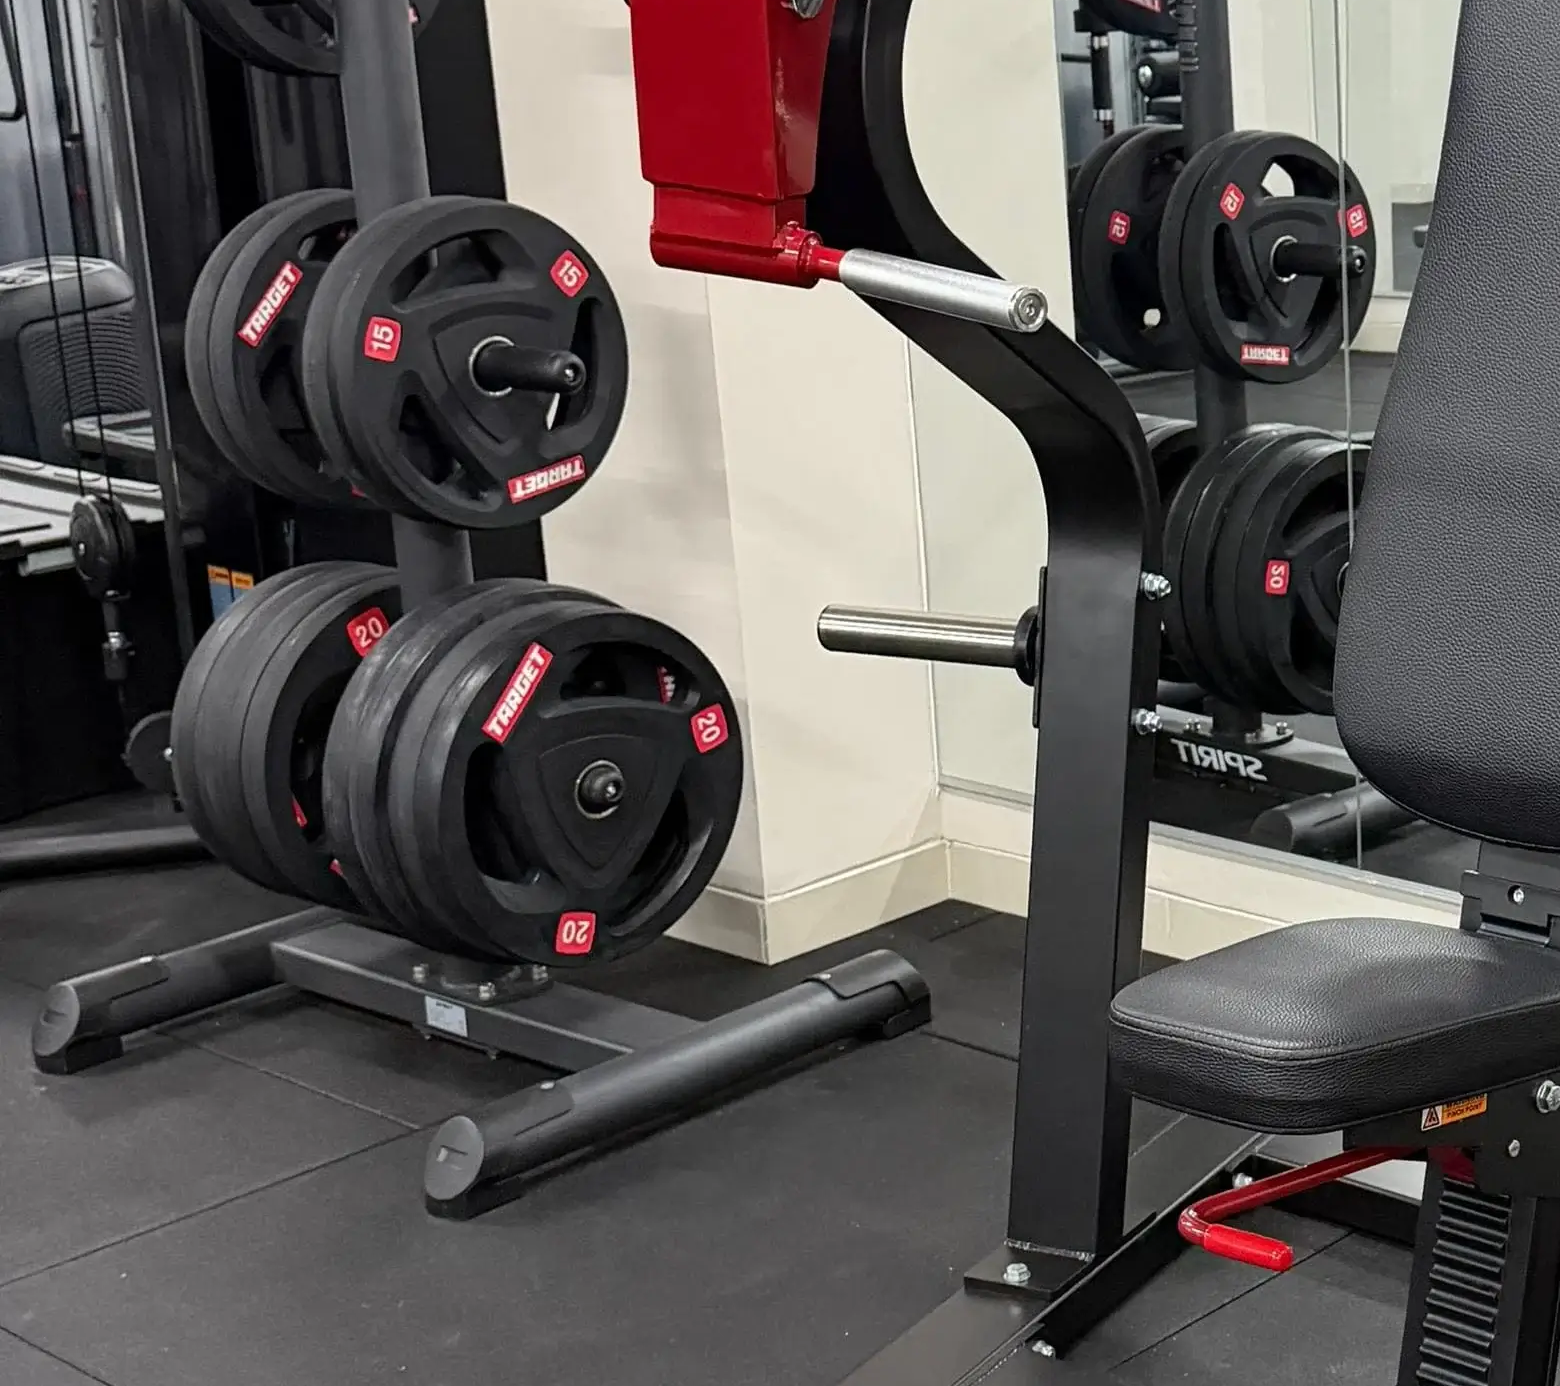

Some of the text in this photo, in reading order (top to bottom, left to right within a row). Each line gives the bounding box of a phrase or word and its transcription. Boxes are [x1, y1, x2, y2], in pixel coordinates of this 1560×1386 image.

[557, 259, 582, 287] 15
[241, 262, 296, 342] TARGET
[371, 324, 394, 350] 15
[512, 459, 585, 498] TARGET
[355, 616, 383, 648] 20
[487, 643, 546, 736] TARGET
[697, 712, 720, 743] 20
[562, 920, 590, 944] 20
